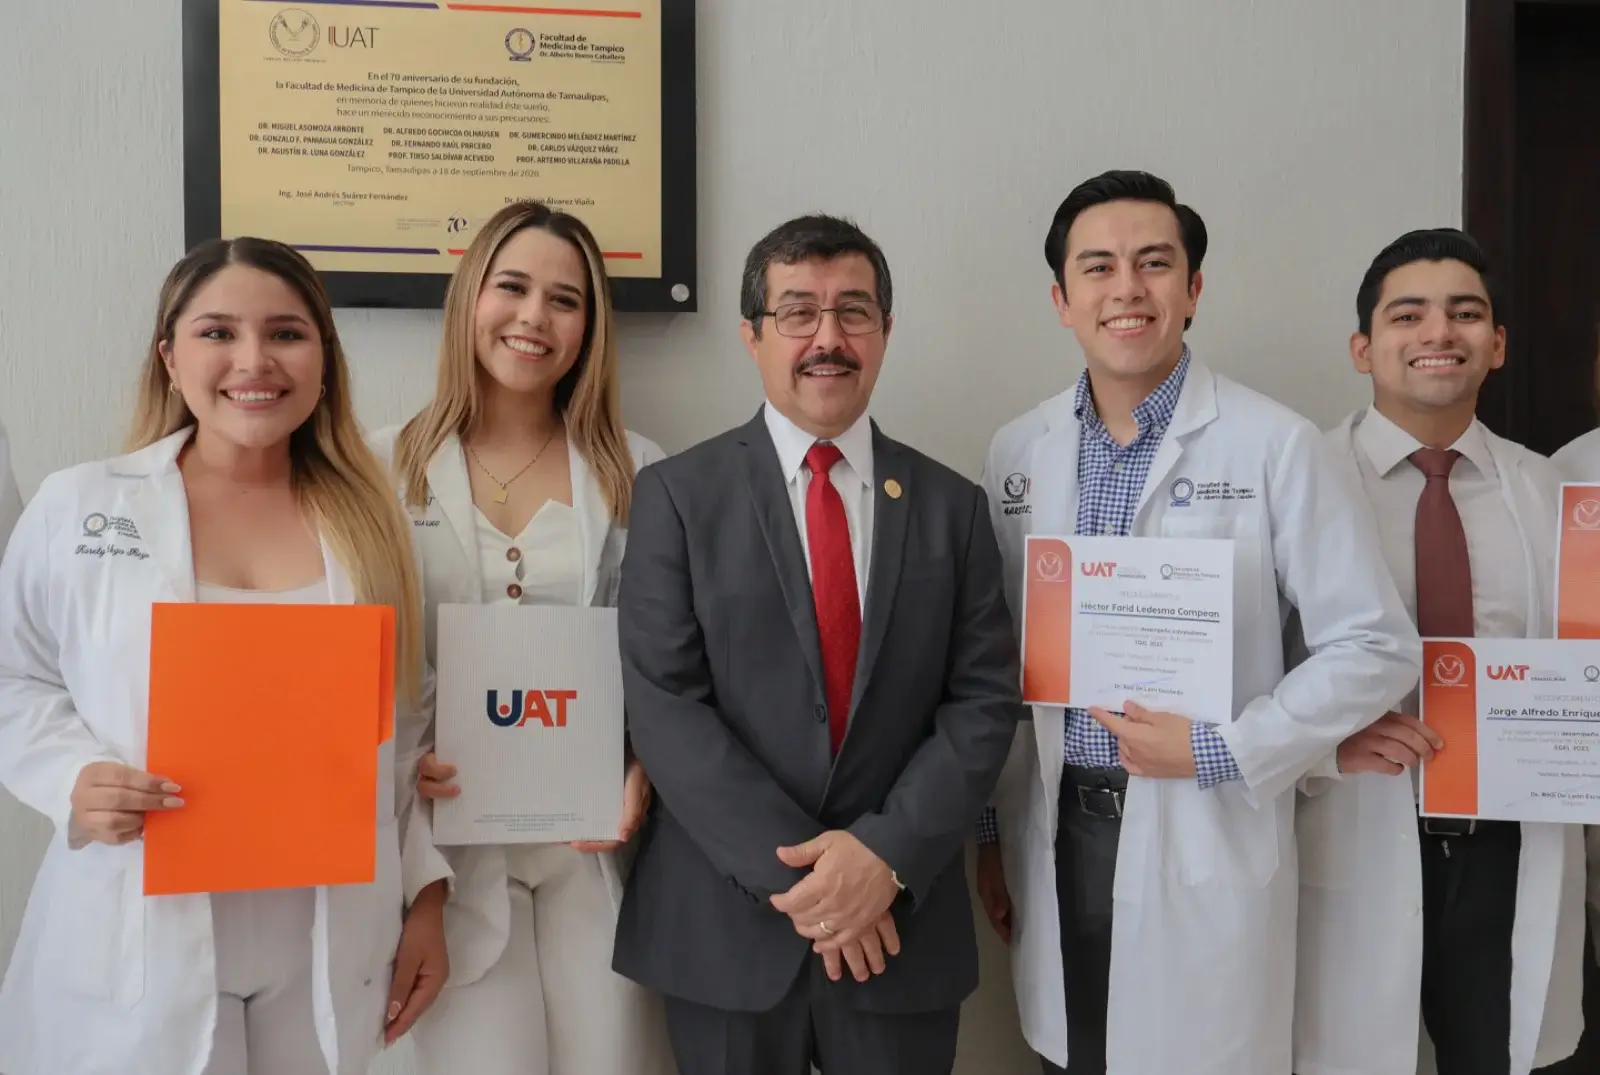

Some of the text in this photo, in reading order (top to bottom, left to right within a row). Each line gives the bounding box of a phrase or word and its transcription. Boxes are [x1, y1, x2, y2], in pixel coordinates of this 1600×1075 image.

[540, 33, 574, 42] Facultad
[590, 44, 624, 53] Tampico
[368, 72, 380, 80] En
[381, 72, 388, 81] el
[391, 73, 400, 81] 70
[402, 73, 449, 83] aniversario
[451, 75, 462, 83] de
[474, 76, 519, 86] fundación,
[276, 81, 608, 102] la Facultad de Medicina de Tampico de la Universidad Autónoma de Tamaulipas,
[349, 97, 387, 105] memoria
[388, 96, 399, 106] de
[401, 98, 433, 108] quienes
[435, 99, 468, 108] hicieron
[470, 100, 503, 110] realidad
[371, 109, 410, 118] merecido
[412, 110, 476, 120] reconocimiento
[271, 123, 298, 131] MIGUEL
[299, 123, 332, 132] ASOMOZA
[333, 124, 364, 133] ARRONTE
[464, 129, 500, 138] OLHAUSEN
[262, 135, 294, 143] GONZALO
[303, 136, 337, 145] PANIAGUA
[338, 136, 373, 146] GONZÁLEZ
[522, 132, 566, 140] GUMERCINDO
[568, 132, 602, 141] MELÉNDEZ
[603, 132, 636, 142] MARTÍNEZ
[404, 140, 440, 148] FERNANDO
[442, 140, 458, 149] RAÚL
[567, 144, 596, 154] VÁZQUEZ
[598, 145, 618, 153] YÁÑEZ
[271, 147, 300, 156] AGUSTÍN
[330, 149, 365, 158] GONZÁLEZ
[388, 152, 409, 160] PROF.
[431, 152, 463, 161] SALDÍVAR
[464, 154, 494, 162] ACEVEDO
[567, 156, 602, 165] VILLAFAÑA
[603, 158, 630, 166] PADILLA
[348, 164, 384, 174] Tampico,
[385, 166, 430, 175] Tamaulipas
[450, 167, 460, 175] de
[462, 168, 507, 177] septiembre
[279, 190, 408, 201] Ing. José Andrés Suárez Fernández
[1081, 561, 1116, 577] UAT
[1080, 601, 1219, 618] Héctor Farid Ledesma Compean
[1486, 664, 1530, 681] UAT
[487, 690, 577, 727] UAT
[1488, 707, 1517, 717] Jorge
[1521, 708, 1559, 717] Alfredo
